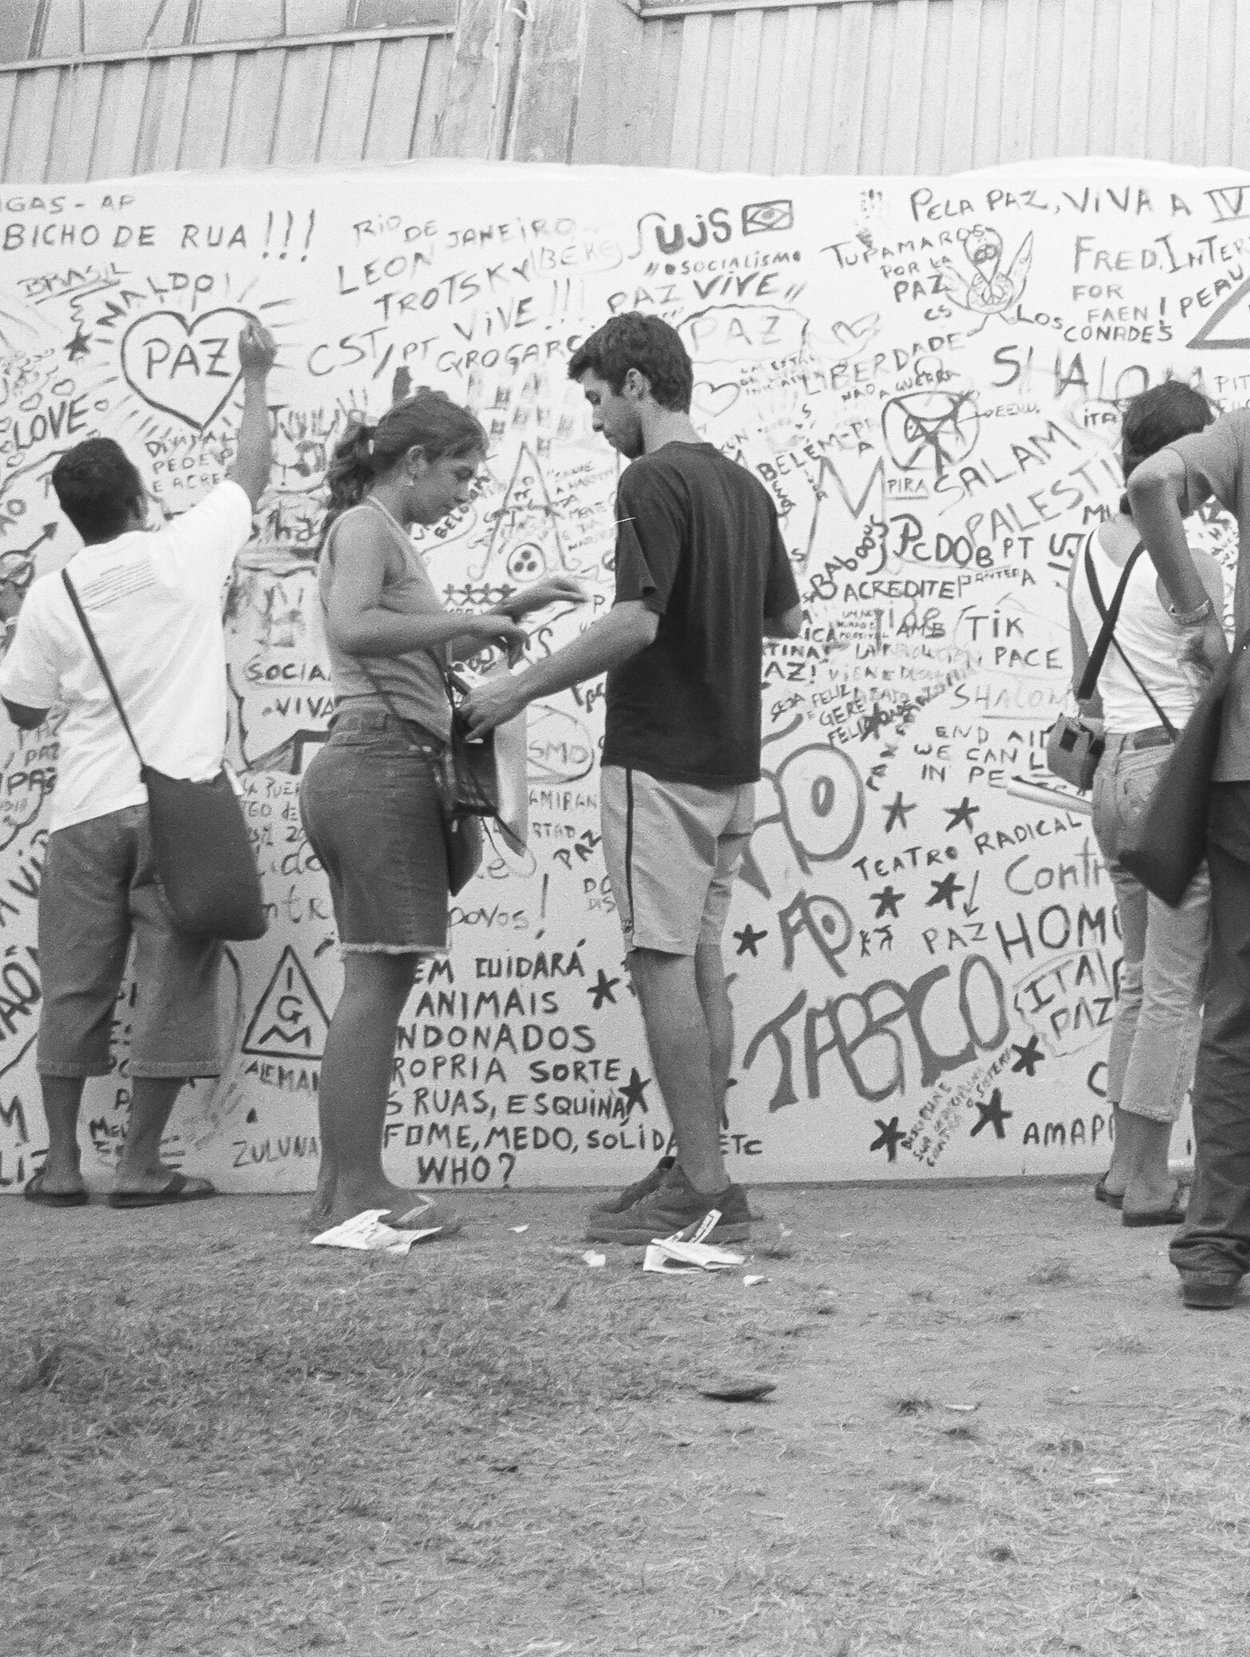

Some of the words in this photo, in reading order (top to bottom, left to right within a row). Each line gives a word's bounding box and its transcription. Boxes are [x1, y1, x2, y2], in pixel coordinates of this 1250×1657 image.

[1171, 194, 1193, 217] A
[2, 222, 100, 251] BICHO
[112, 224, 156, 248] DE
[180, 223, 248, 249] RUA
[404, 220, 438, 243] DE
[338, 250, 434, 296] LEON
[893, 273, 951, 303] PAZ
[373, 259, 532, 322] TROTSKY
[607, 283, 676, 314] PAZ
[690, 316, 782, 352] PAZ
[142, 337, 232, 380] PAZ
[13, 392, 89, 450] LOVE
[1003, 537, 1034, 560] PT
[844, 580, 956, 603] ACREDITE
[246, 662, 331, 682] SOCIA
[995, 647, 1064, 670] PACE
[966, 747, 1018, 764] CAN
[922, 764, 947, 782] IN
[553, 829, 602, 870] PAZ
[852, 845, 960, 882] TEATRO
[974, 812, 1083, 855] RADICAL
[922, 922, 988, 954] PAZ
[416, 989, 560, 1020] ANIMAIS
[529, 1057, 622, 1084] SORTE
[413, 1086, 498, 1122] RUAS,
[484, 1125, 580, 1155] MEDO,
[417, 1151, 518, 1189] WHO?
